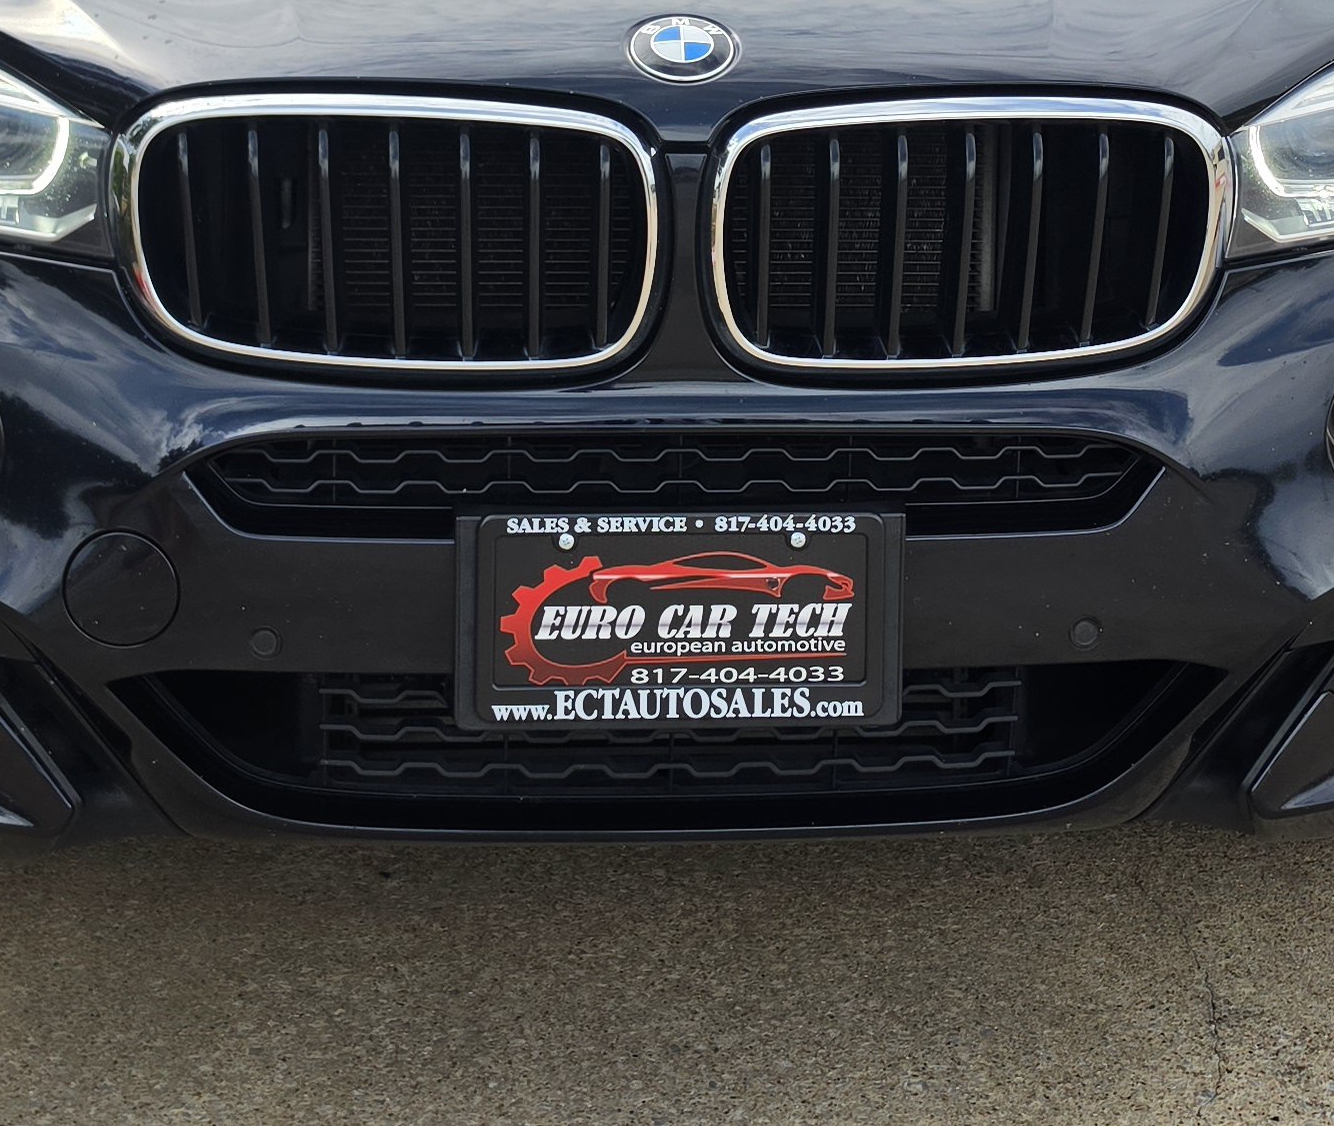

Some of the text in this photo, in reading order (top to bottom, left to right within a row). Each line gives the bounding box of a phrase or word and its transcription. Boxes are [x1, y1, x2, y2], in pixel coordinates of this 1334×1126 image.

[506, 514, 857, 535] SALES & SERVICE 817-404-4033
[534, 602, 853, 640] EURO CAR TECH
[630, 637, 847, 657] european automotive
[630, 665, 845, 684] 817-404-4033
[490, 686, 865, 722] www.ECTAUTOSALES.com
